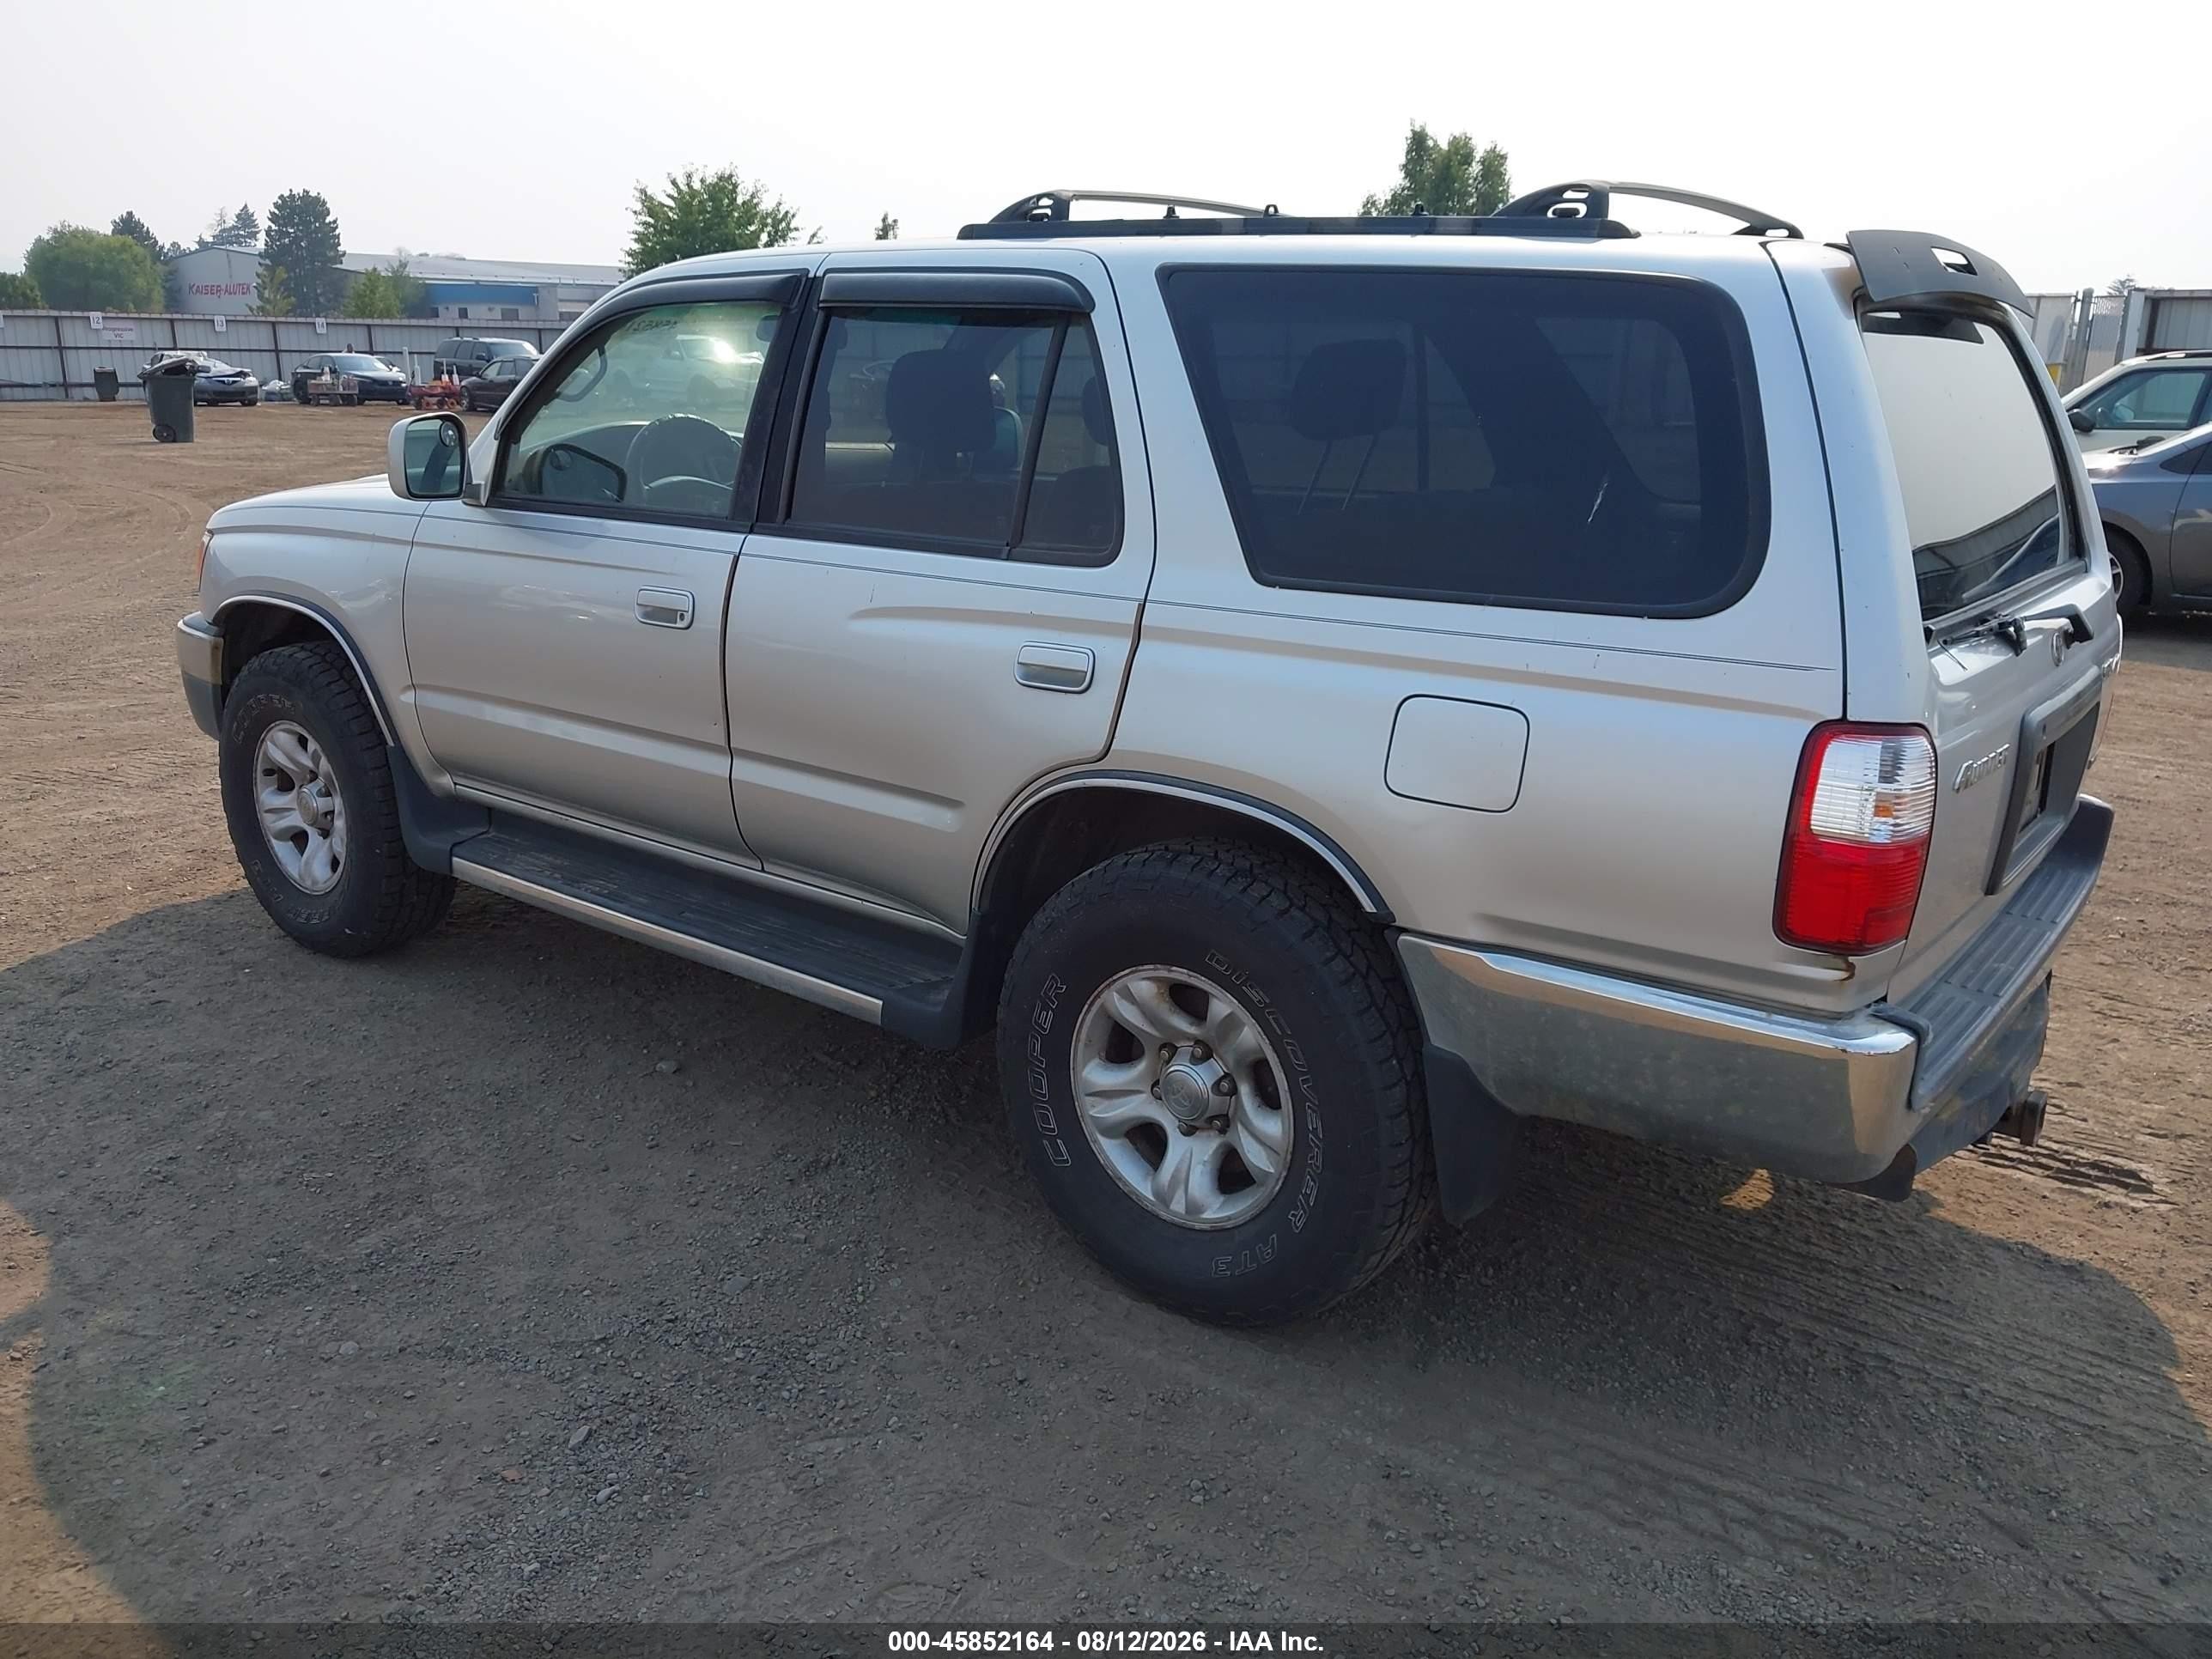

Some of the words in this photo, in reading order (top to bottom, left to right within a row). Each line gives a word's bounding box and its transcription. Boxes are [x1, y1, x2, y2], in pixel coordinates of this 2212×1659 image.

[92, 315, 100, 325] 12
[1028, 972, 1073, 1168] COOPER
[1211, 1233, 1278, 1278] AT3
